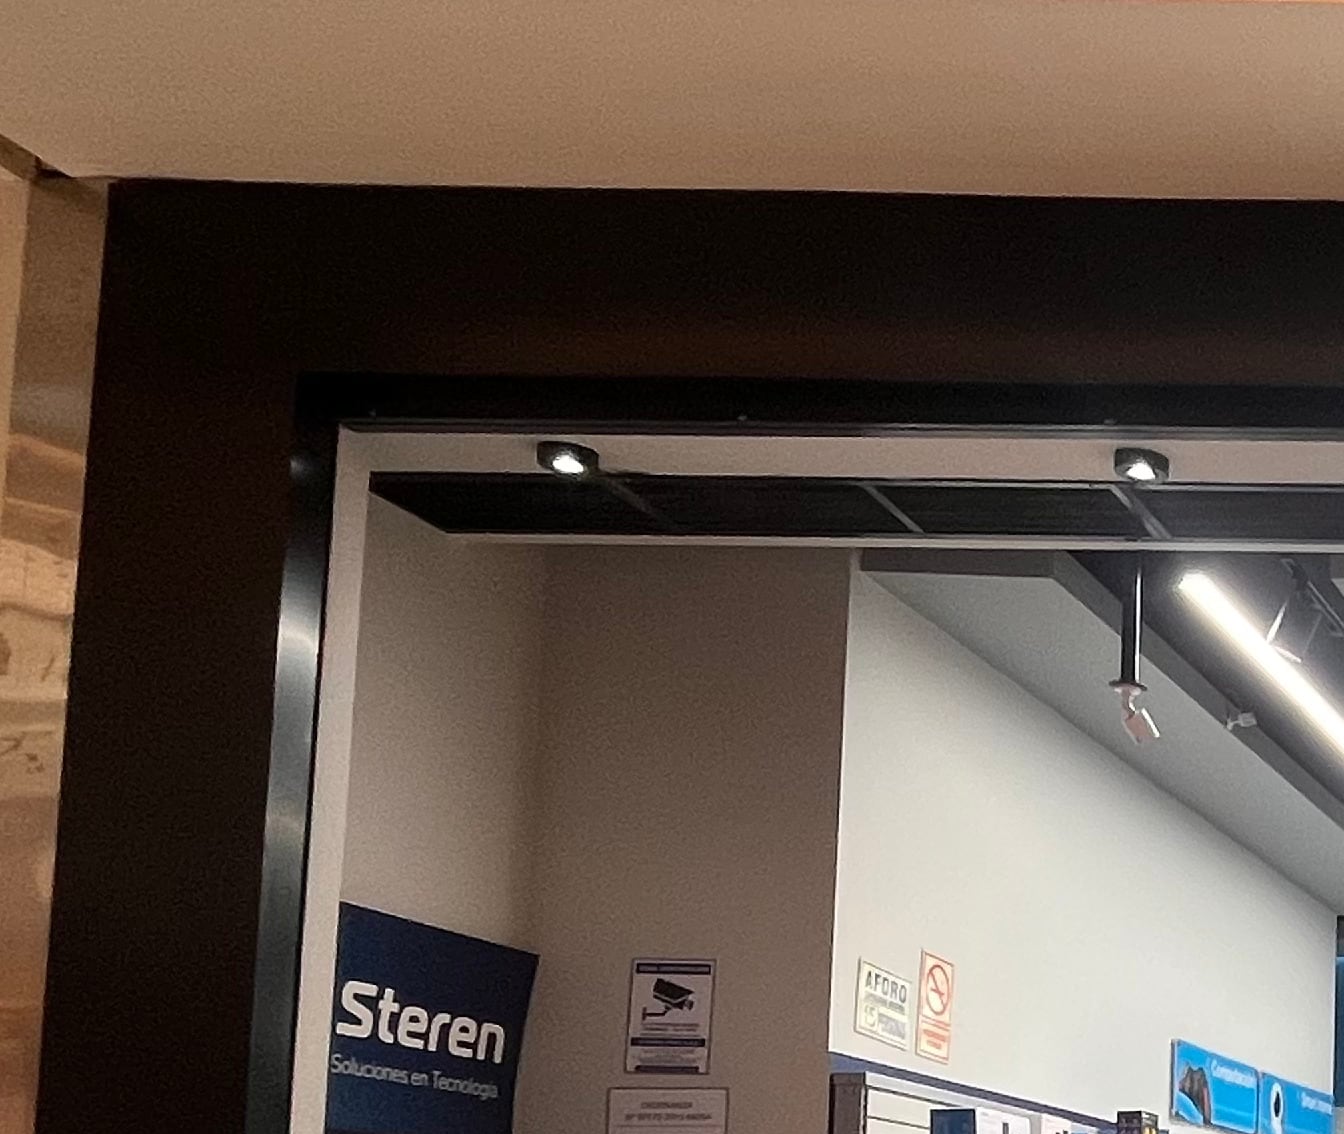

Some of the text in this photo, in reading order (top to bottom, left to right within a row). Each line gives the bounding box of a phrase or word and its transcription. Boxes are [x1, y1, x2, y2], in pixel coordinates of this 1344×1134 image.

[865, 970, 908, 1004] AFORO
[335, 979, 507, 1064] Steren
[330, 1053, 409, 1085] Soluciones
[410, 1069, 429, 1088] en
